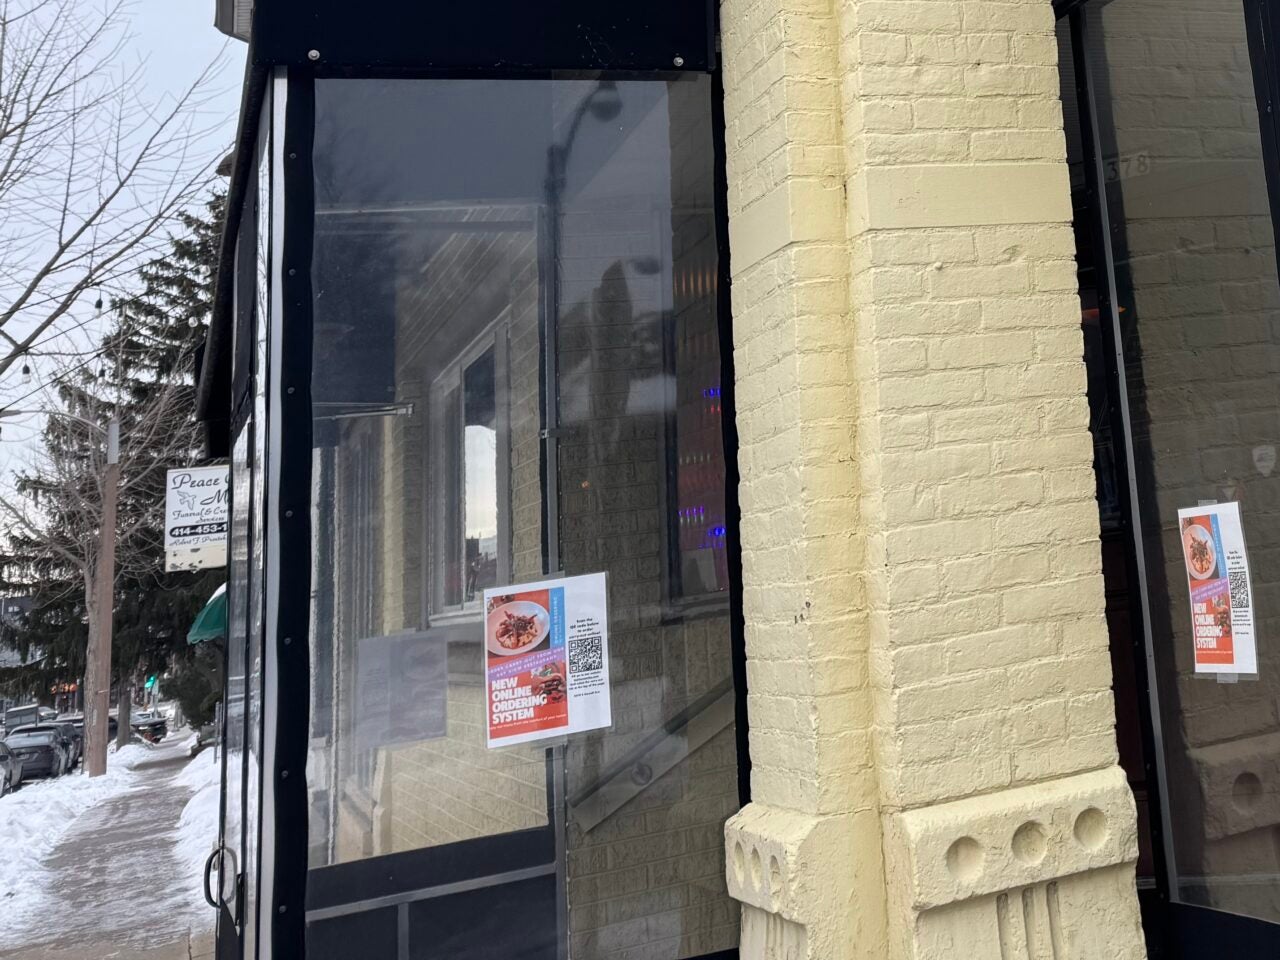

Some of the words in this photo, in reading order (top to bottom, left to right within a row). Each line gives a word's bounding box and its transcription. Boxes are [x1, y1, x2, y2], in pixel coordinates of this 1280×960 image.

[171, 473, 220, 490] Peace
[172, 508, 204, 520] Funeral
[491, 676, 518, 690] NEW
[492, 685, 531, 701] ONLINE
[492, 693, 547, 714] ORDERING
[492, 706, 534, 725] SYSTEM
